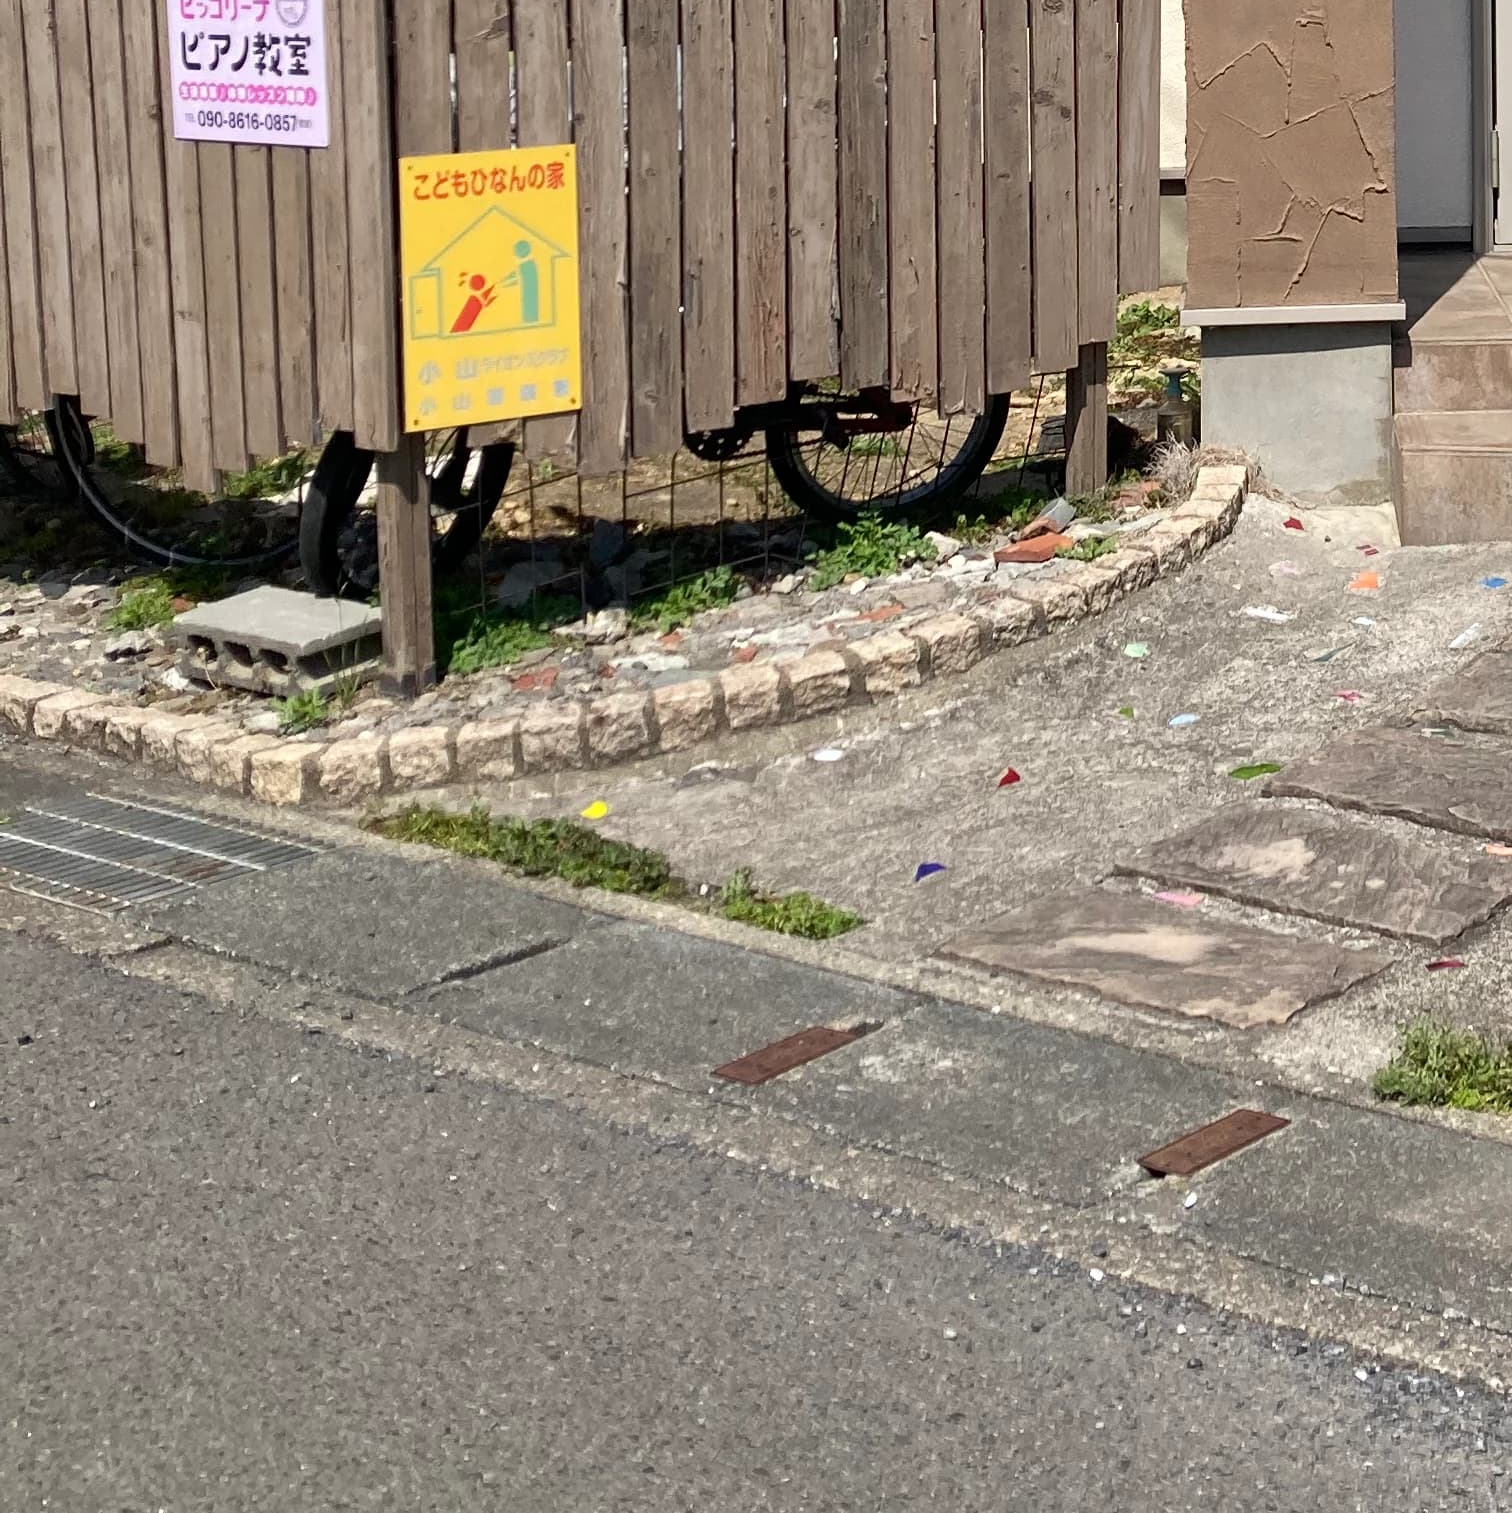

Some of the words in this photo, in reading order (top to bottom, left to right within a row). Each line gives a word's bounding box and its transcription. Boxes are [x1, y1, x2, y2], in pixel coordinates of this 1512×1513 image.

[181, 31, 311, 77] ピアノ教室
[198, 110, 297, 132] 090-8616-0857
[414, 161, 565, 201] こどもひなんの家
